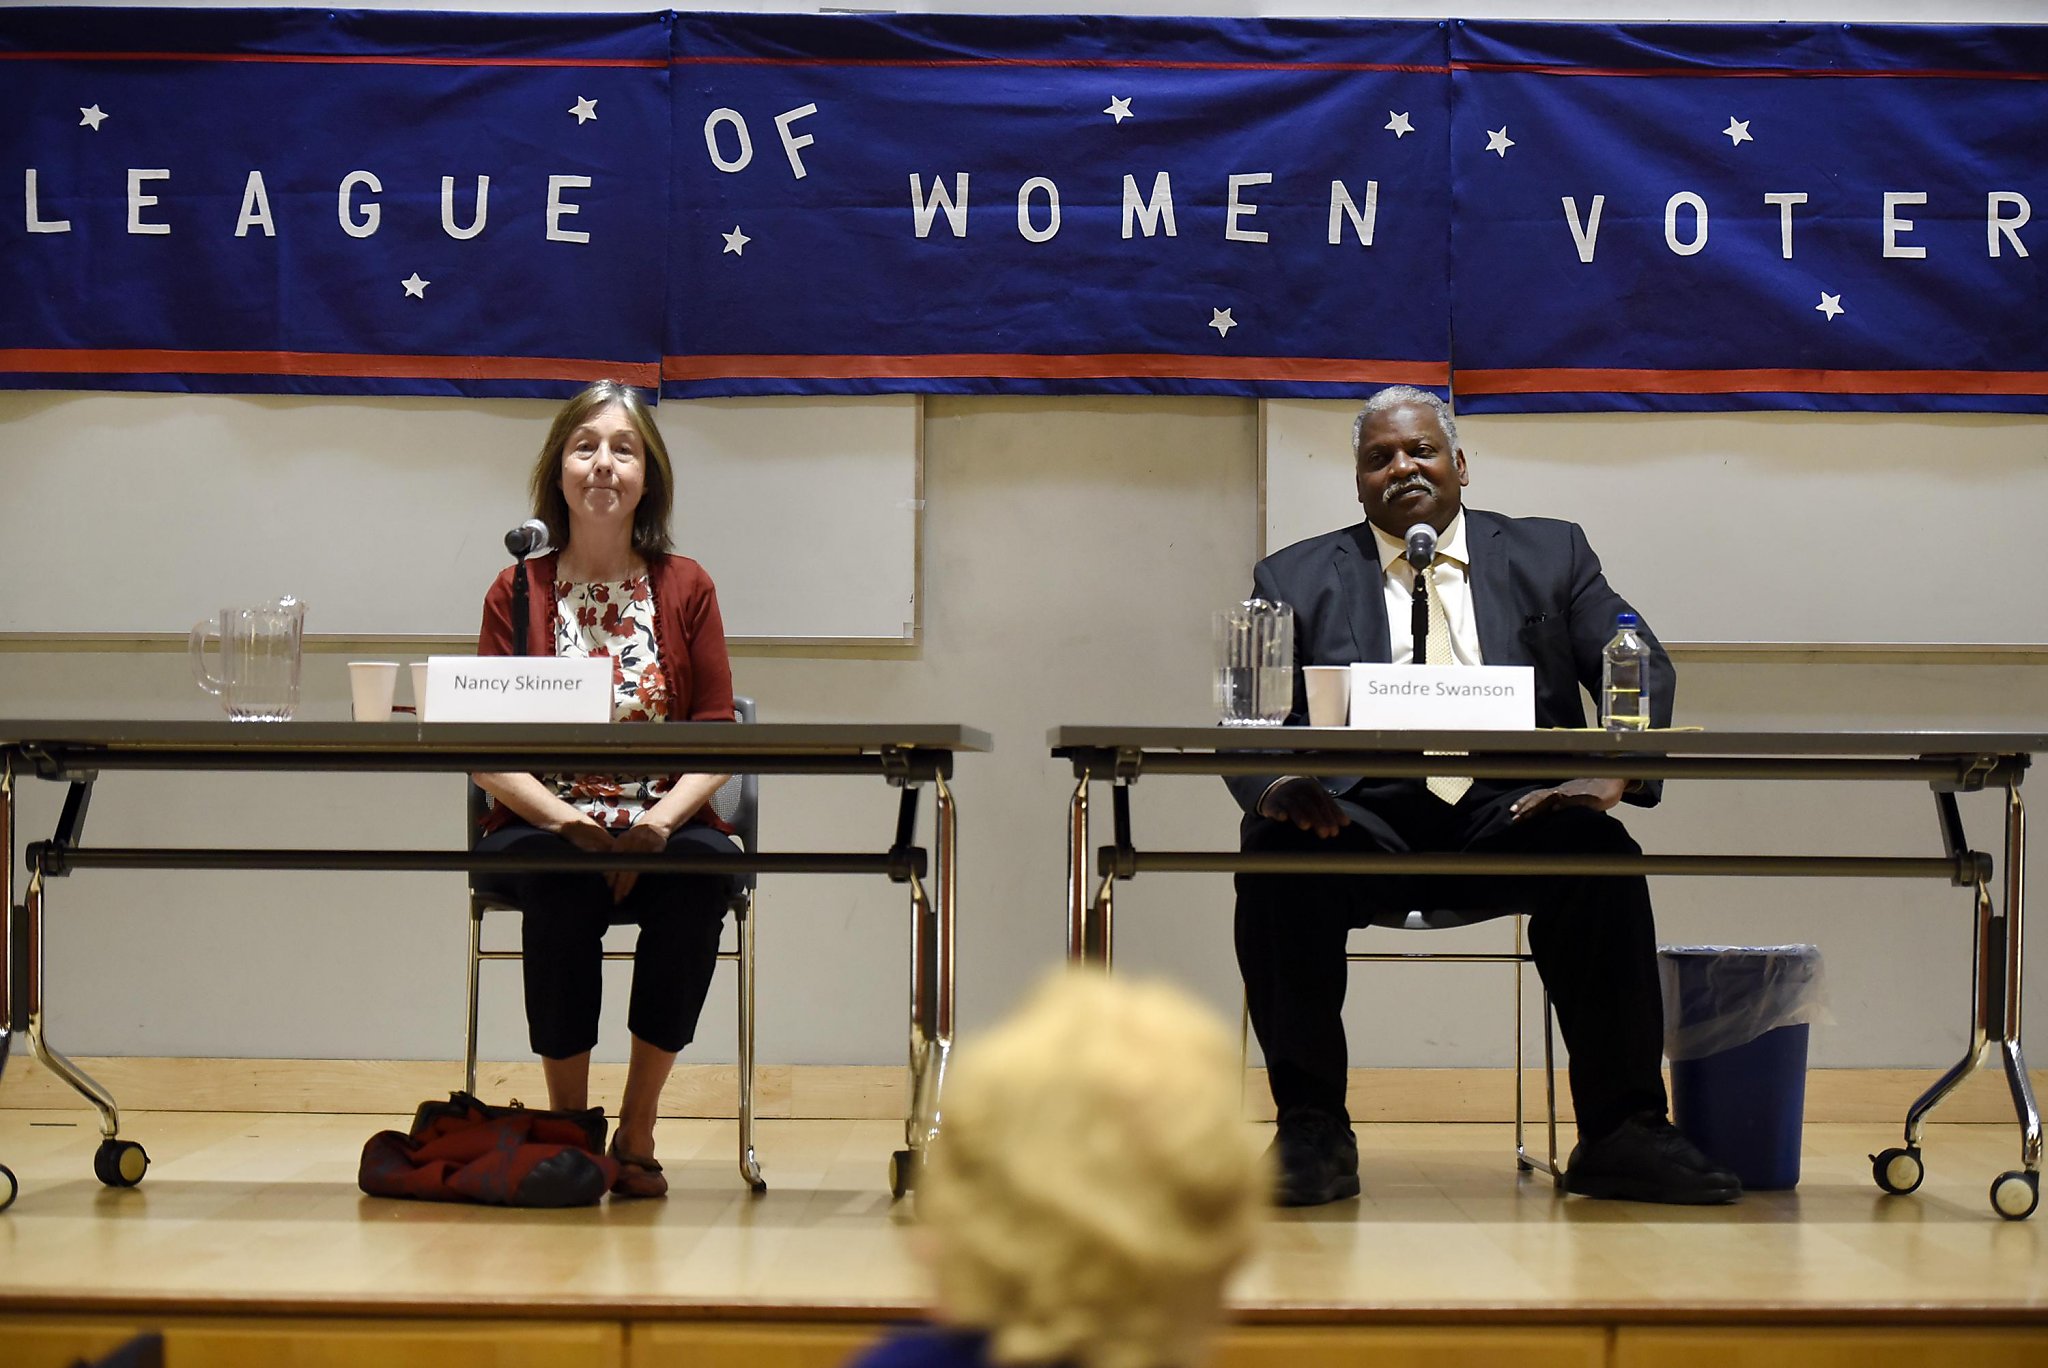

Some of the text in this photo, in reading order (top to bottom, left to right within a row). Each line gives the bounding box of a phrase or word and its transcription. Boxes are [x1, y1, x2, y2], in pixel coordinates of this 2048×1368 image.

[25, 102, 2031, 263] LEAGUE OF WOMEN VOTER
[454, 674, 583, 694] Nancy Skinner
[1368, 680, 1515, 697] Sandre Swanson
